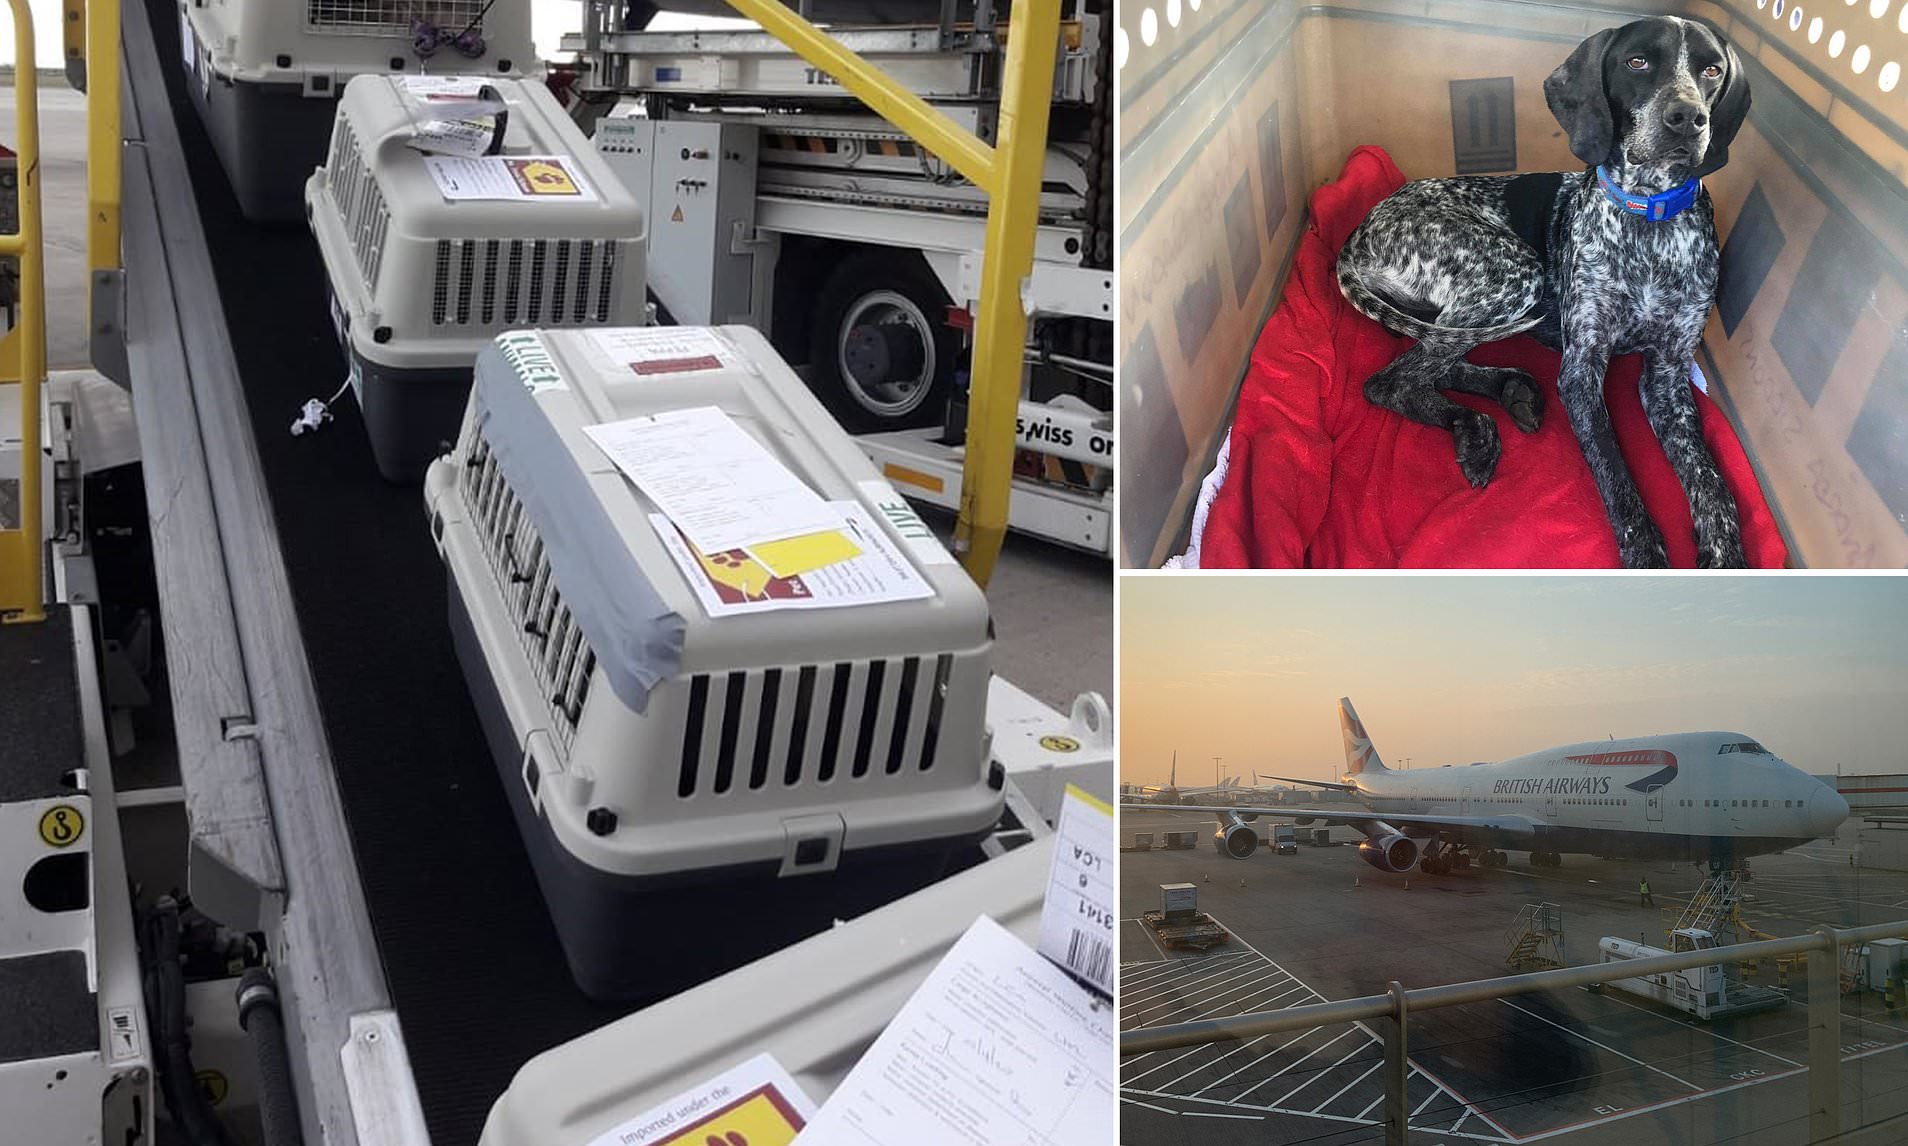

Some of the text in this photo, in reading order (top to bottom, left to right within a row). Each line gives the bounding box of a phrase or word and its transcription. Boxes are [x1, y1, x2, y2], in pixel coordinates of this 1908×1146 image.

[516, 346, 556, 374] LIVE
[879, 503, 934, 539] LIVE
[1493, 776, 1612, 794] BRITISH AIRWAYS
[620, 1085, 731, 1145] Imported under the
[1592, 1104, 1623, 1115] EL
